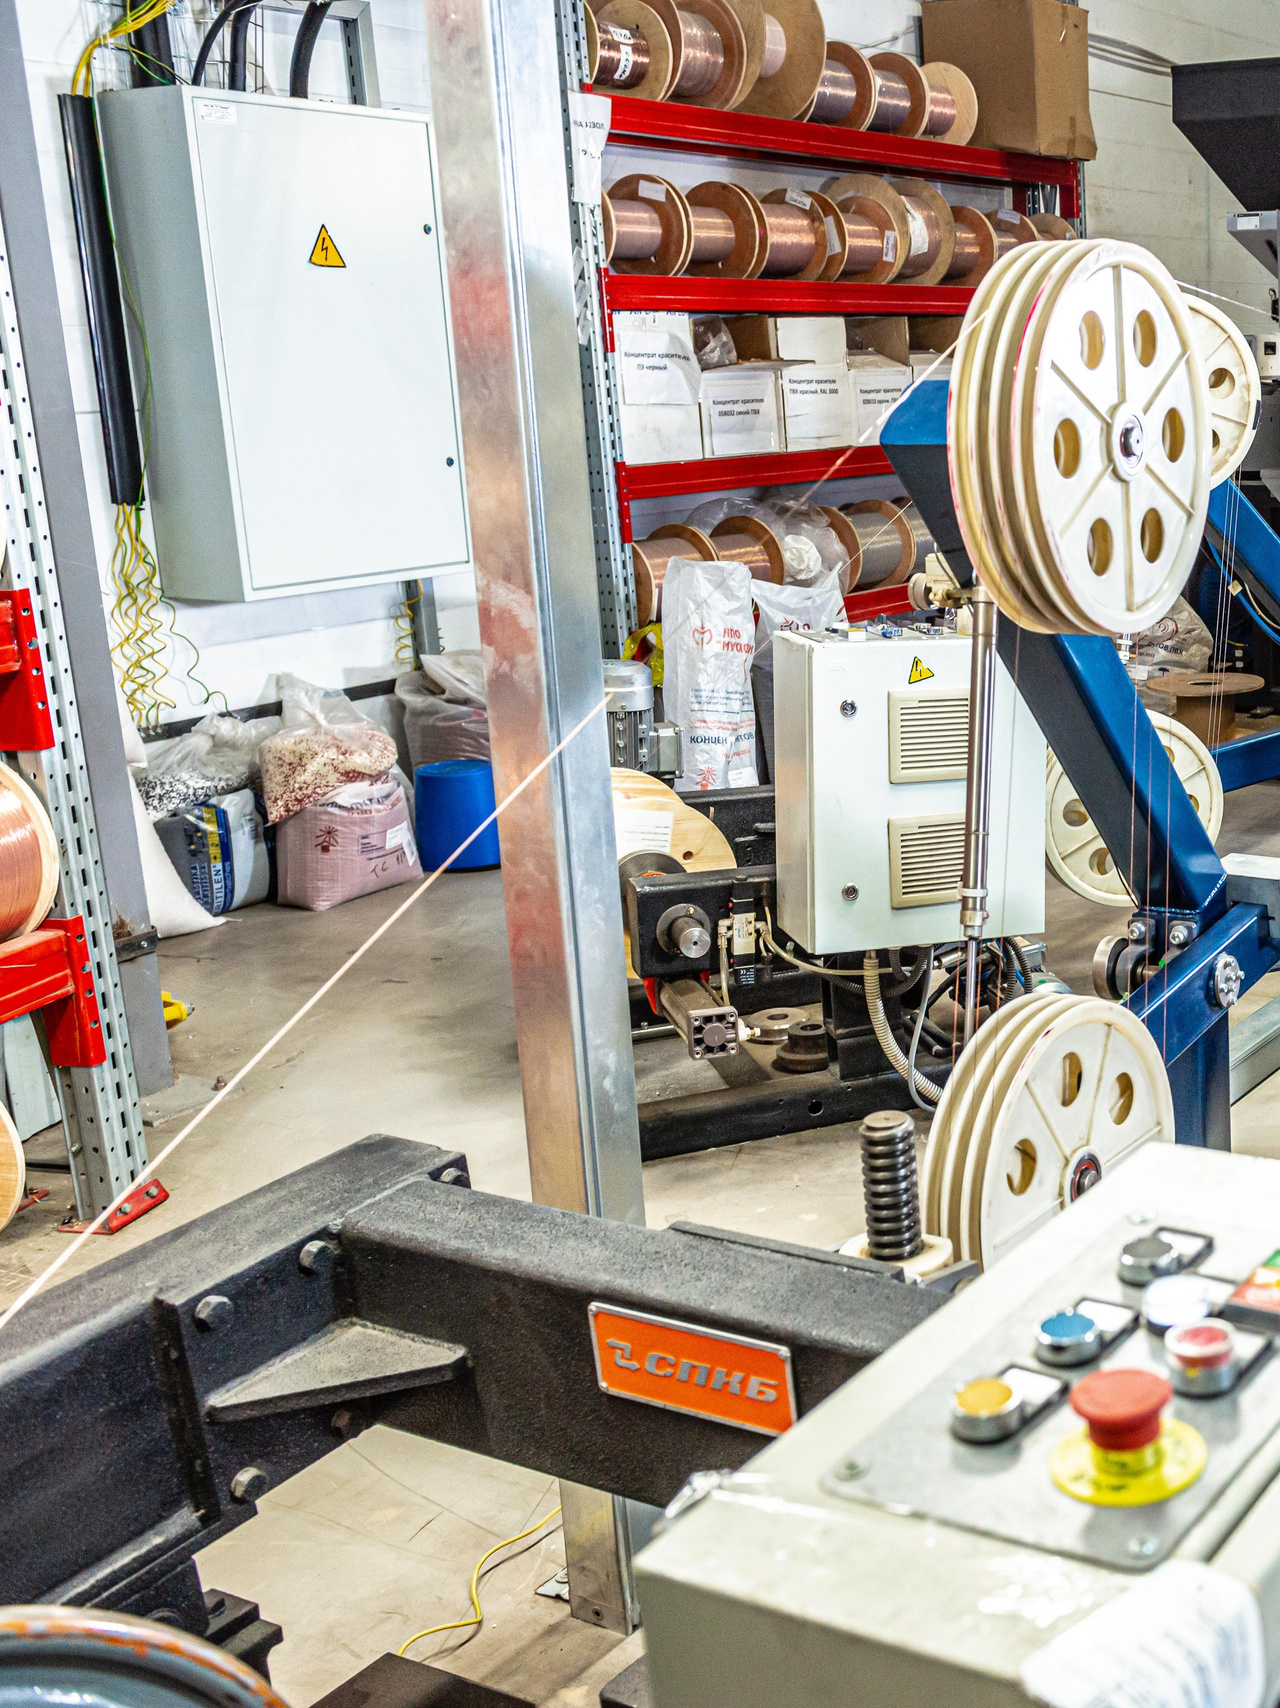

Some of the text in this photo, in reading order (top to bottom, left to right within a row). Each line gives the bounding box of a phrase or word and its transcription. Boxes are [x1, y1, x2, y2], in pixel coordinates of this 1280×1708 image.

[624, 351, 657, 359] Концентрат
[723, 627, 741, 639] НПО
[645, 1352, 778, 1403] СПКБ
